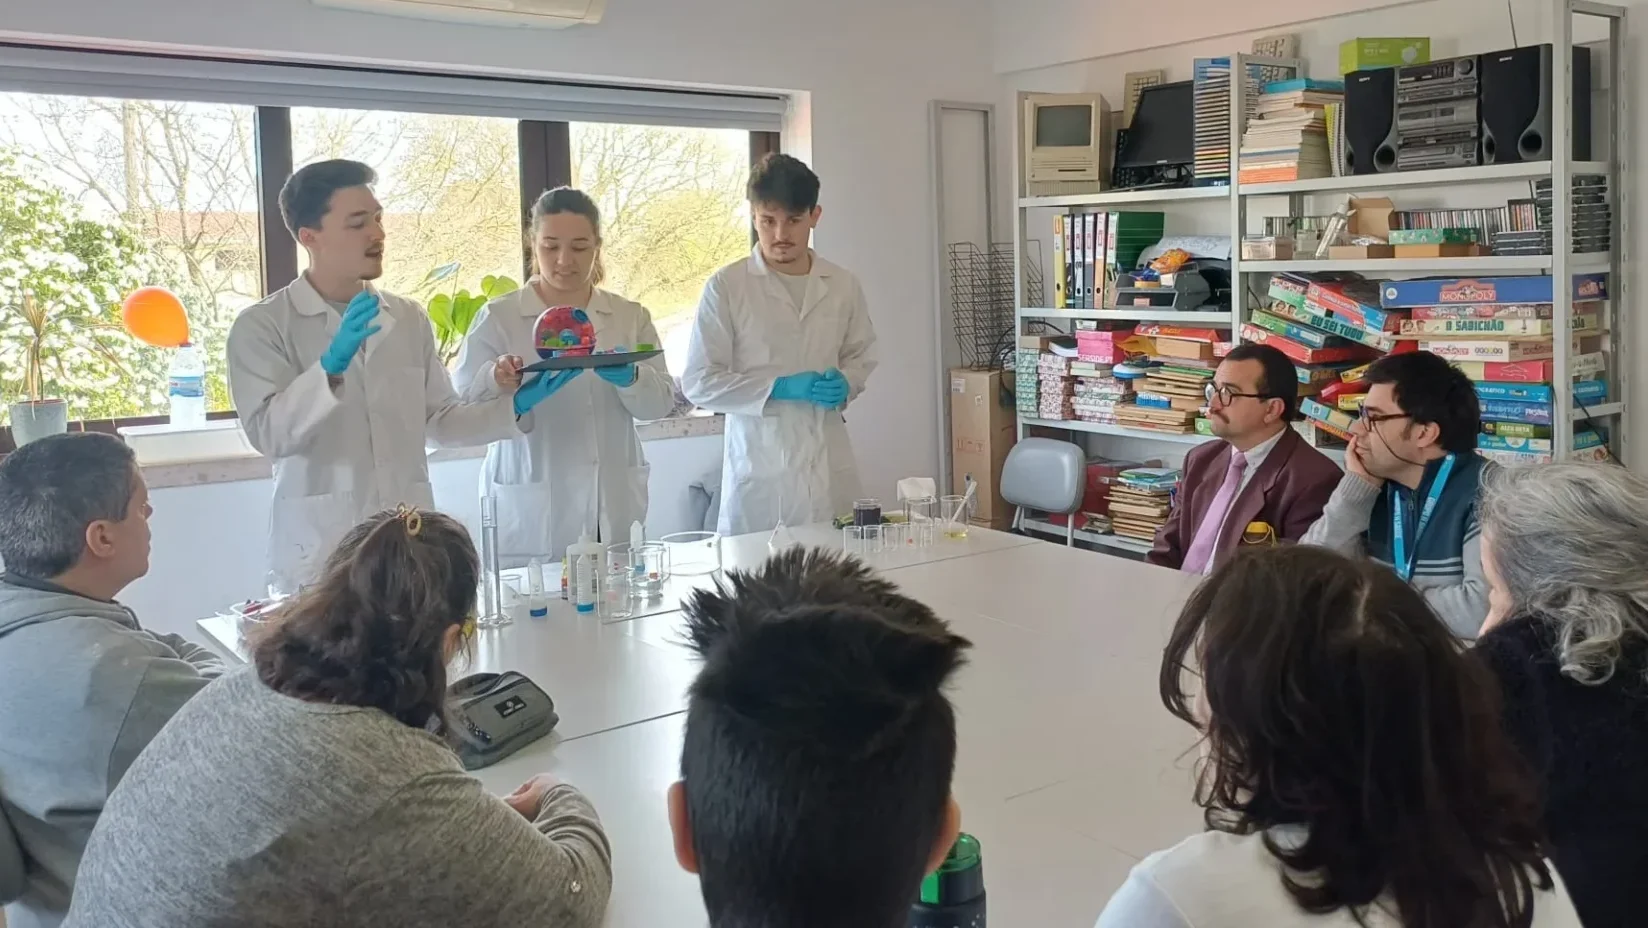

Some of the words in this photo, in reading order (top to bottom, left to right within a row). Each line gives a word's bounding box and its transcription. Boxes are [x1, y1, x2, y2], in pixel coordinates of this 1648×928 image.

[1442, 290, 1494, 301] MONOPOLY
[1311, 315, 1323, 326] EU
[1322, 319, 1338, 332] SEI
[1340, 324, 1365, 340] TUDO
[1446, 321, 1452, 331] O
[1455, 319, 1504, 331] SABICHÃO
